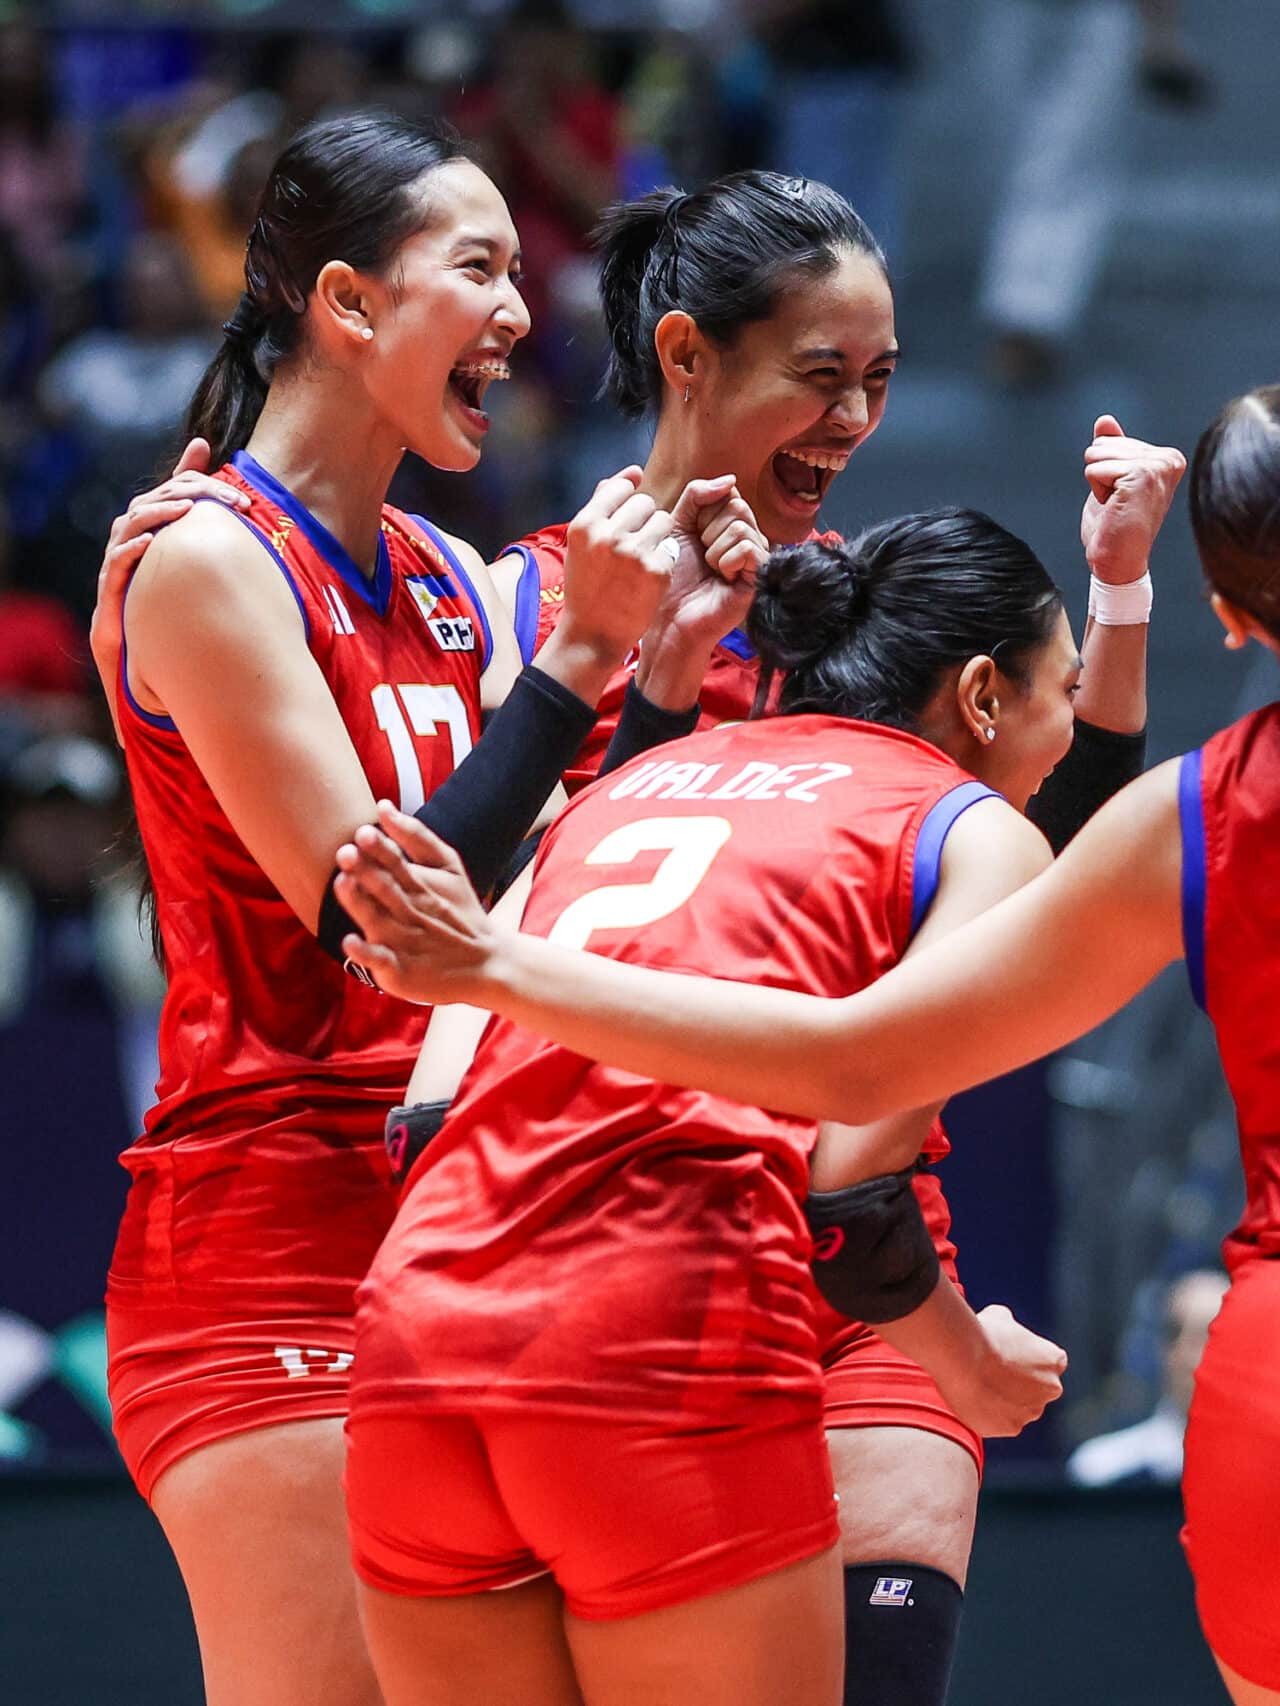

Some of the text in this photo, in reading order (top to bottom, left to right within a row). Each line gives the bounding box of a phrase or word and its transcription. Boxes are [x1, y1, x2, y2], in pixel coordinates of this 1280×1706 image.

[370, 683, 474, 816] 17
[608, 760, 853, 802] VALDEZ
[547, 815, 733, 951] 2
[873, 1578, 910, 1600] LP
